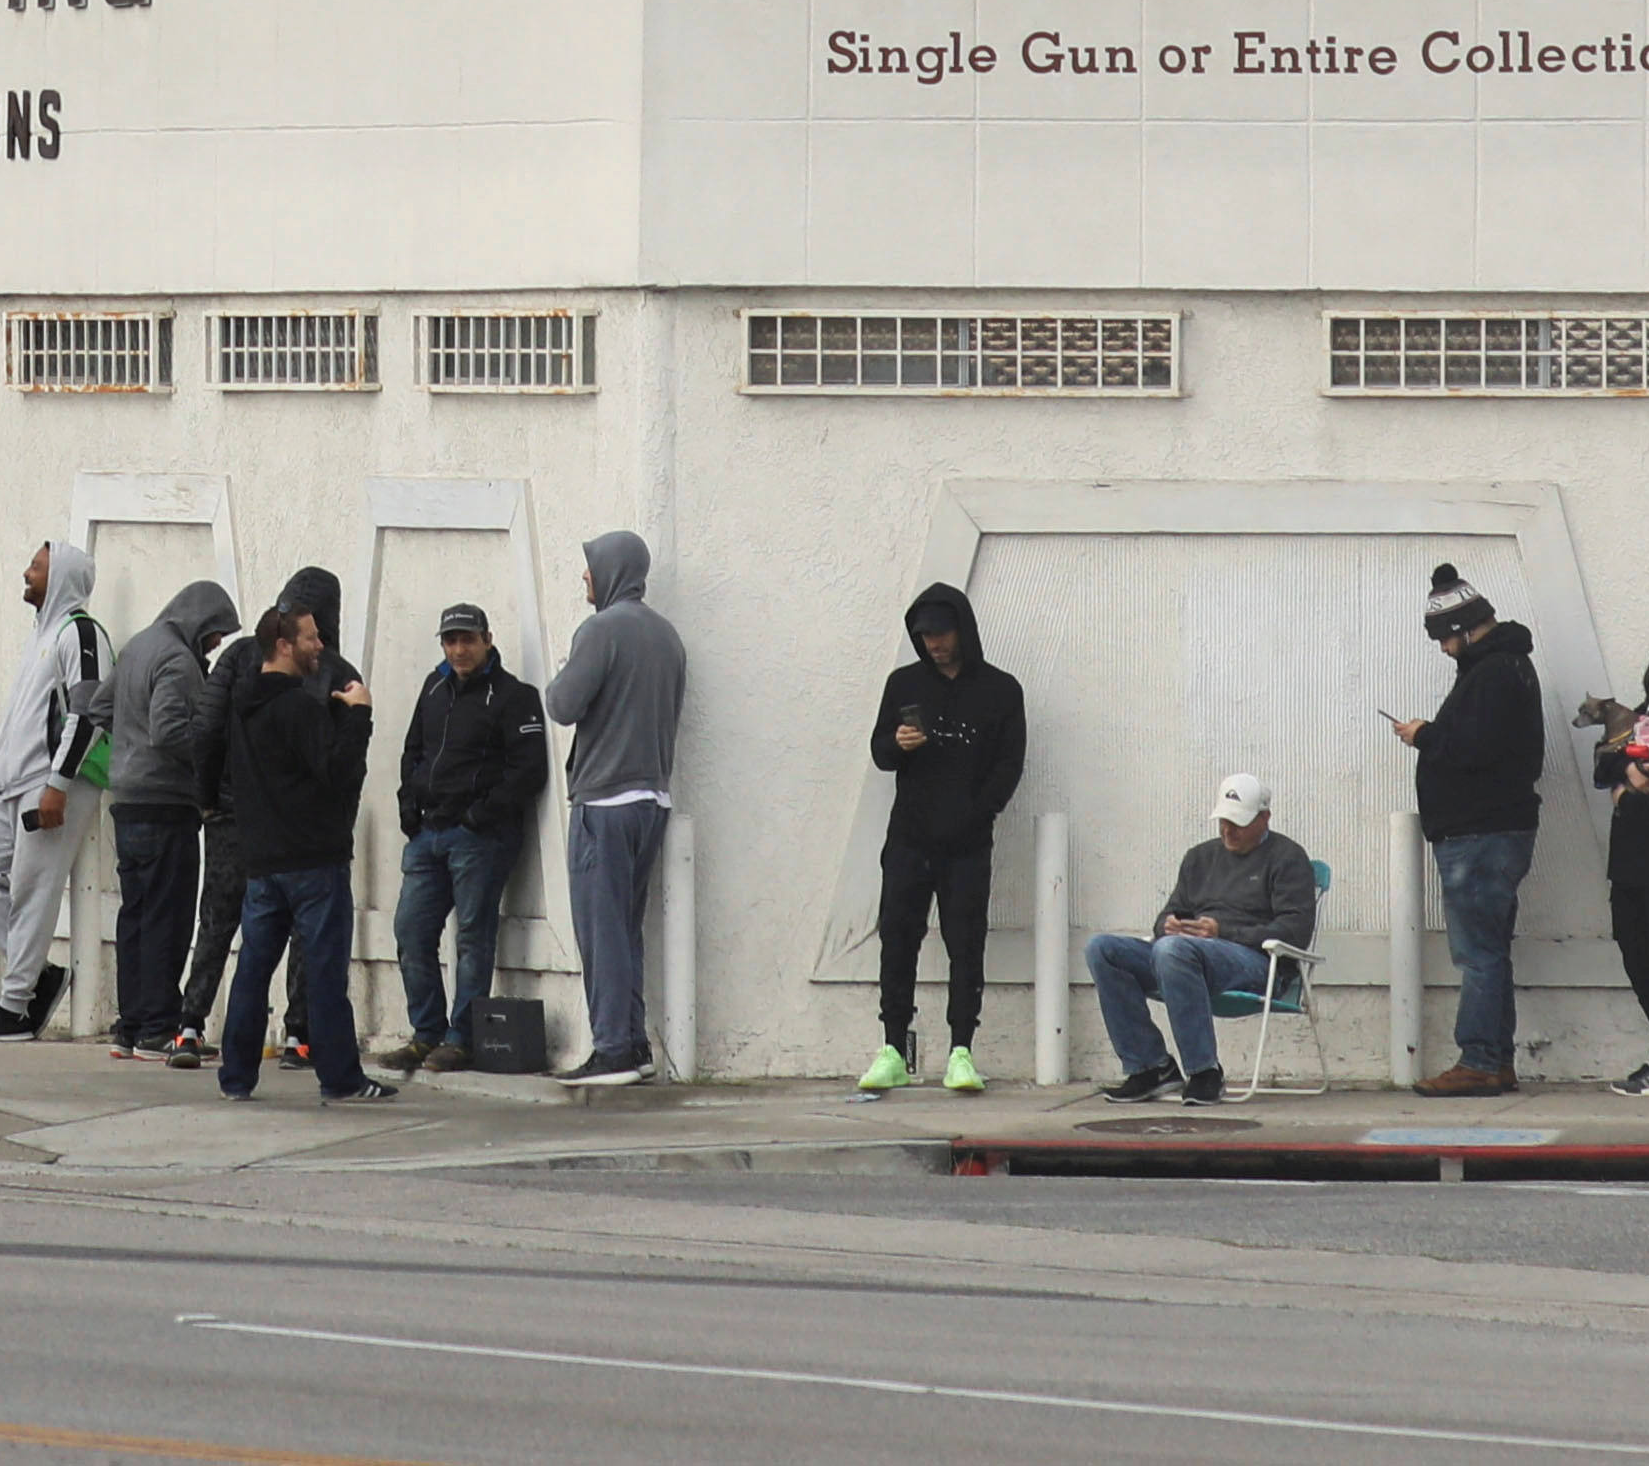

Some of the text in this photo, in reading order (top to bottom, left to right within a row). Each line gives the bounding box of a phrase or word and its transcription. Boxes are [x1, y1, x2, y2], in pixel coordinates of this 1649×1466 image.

[827, 30, 998, 84] Single
[1021, 30, 1138, 74] Gun
[1158, 42, 1208, 74] or
[1233, 30, 1399, 74] Entire
